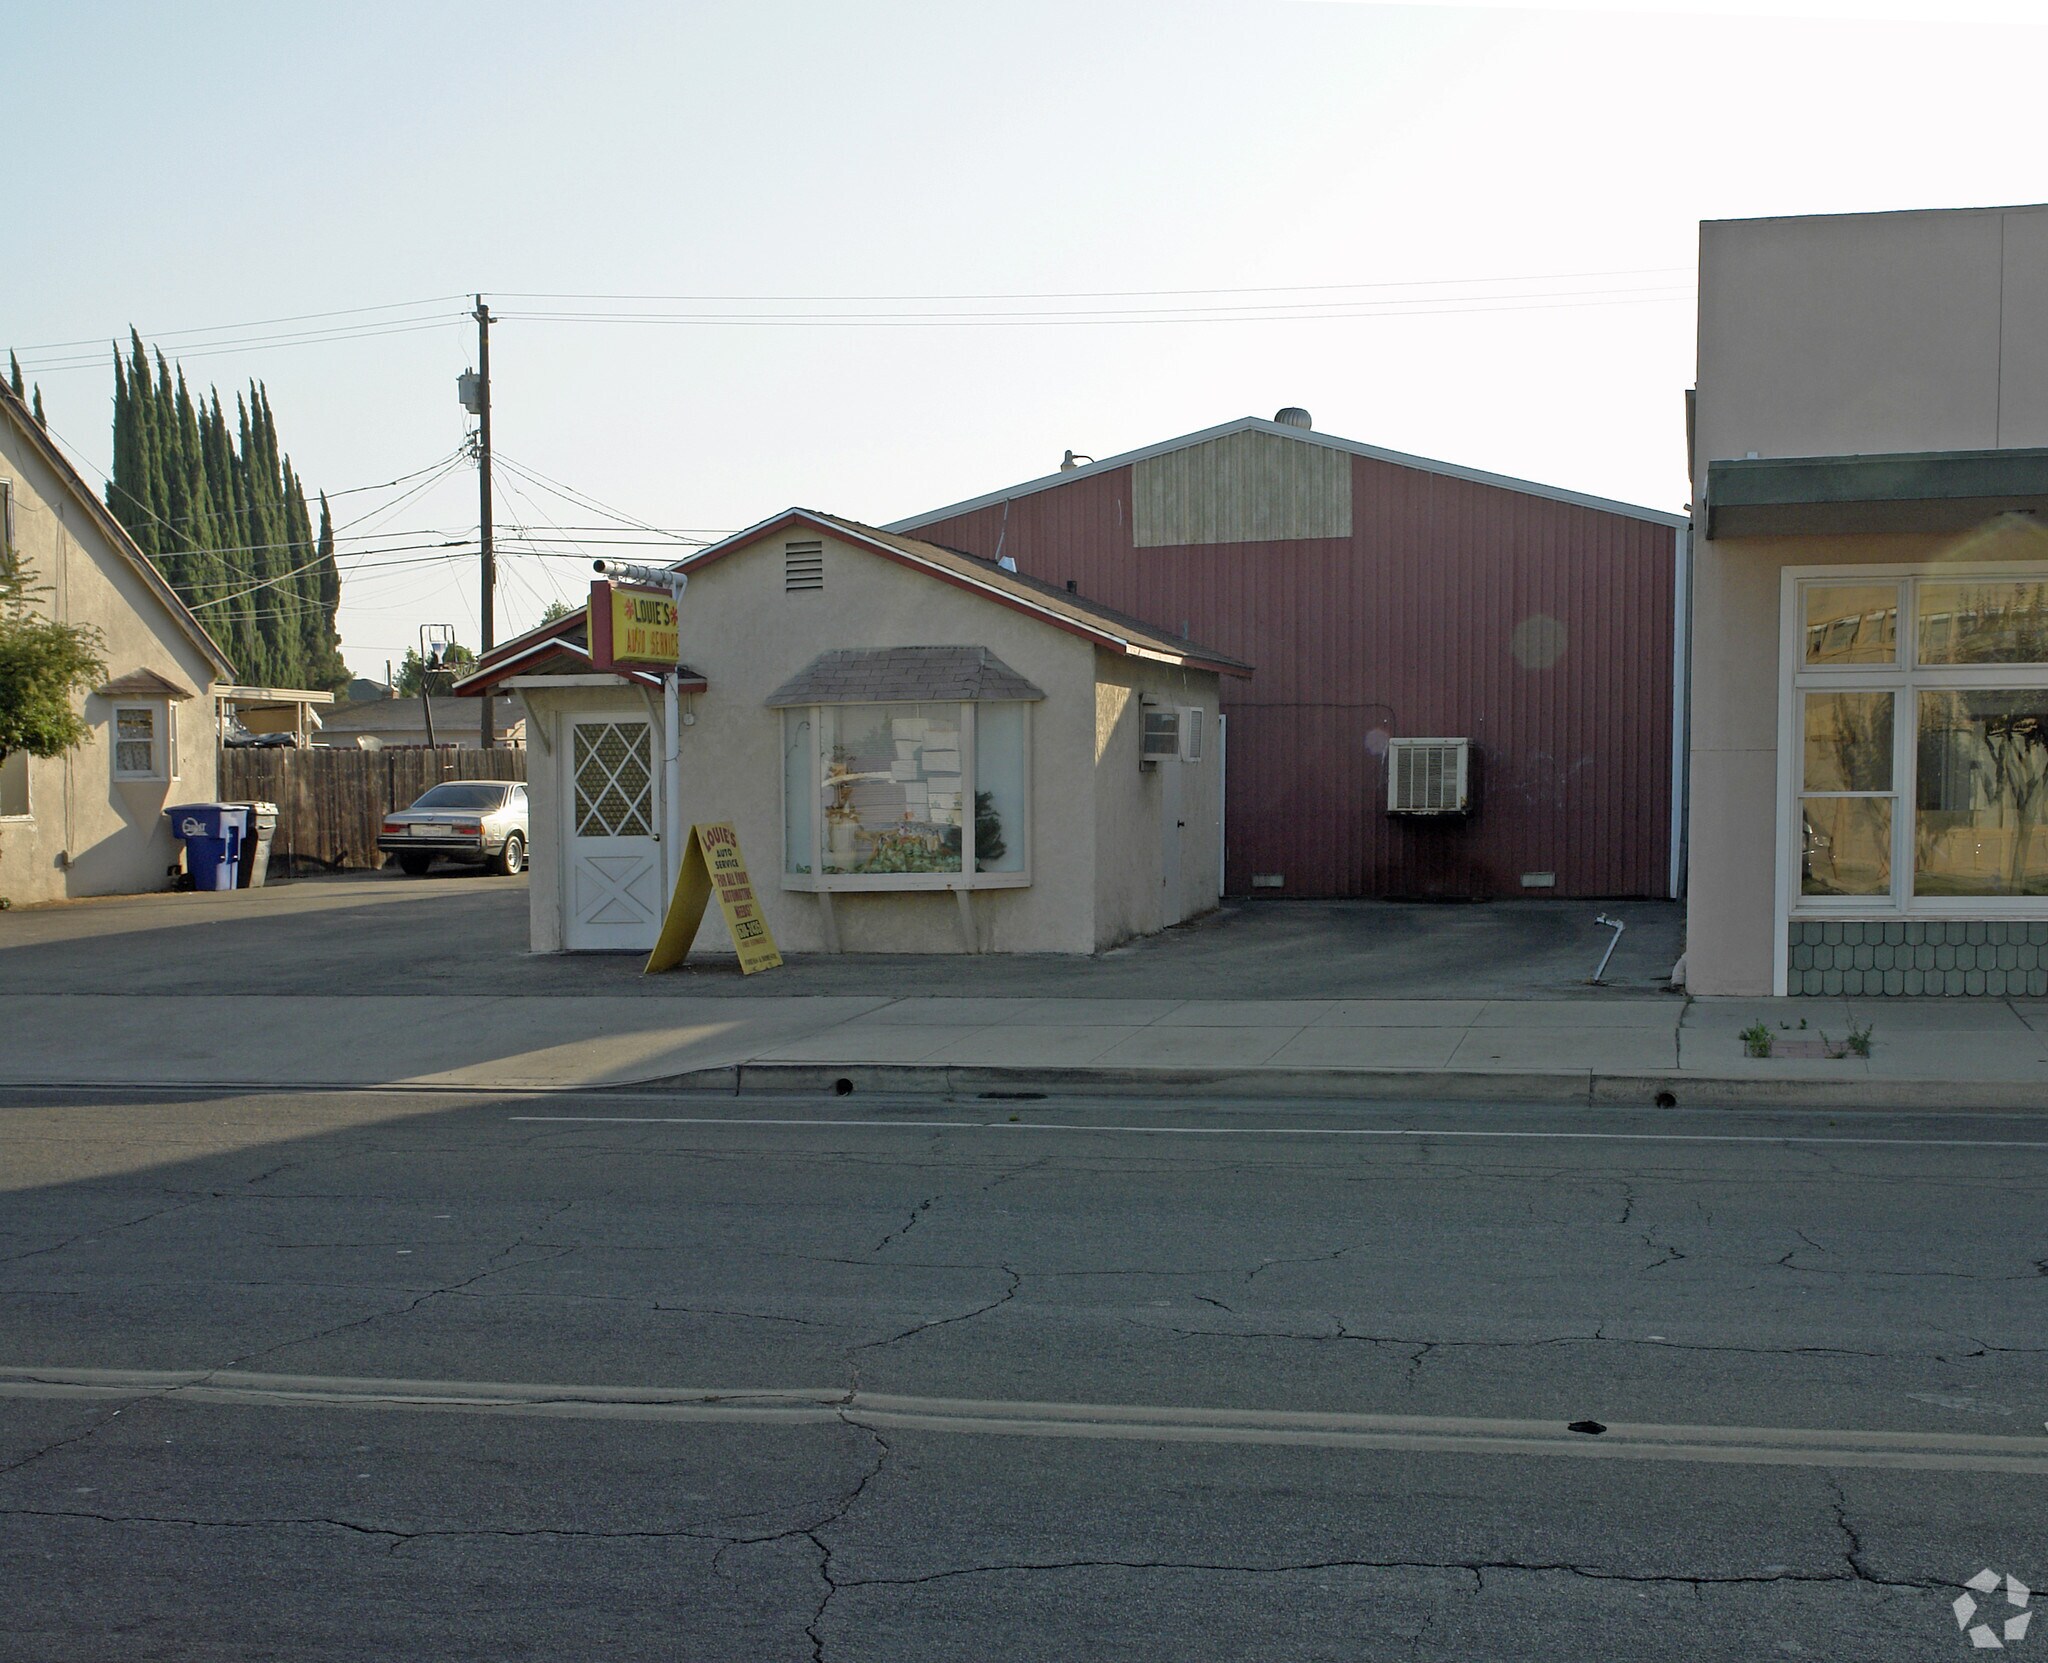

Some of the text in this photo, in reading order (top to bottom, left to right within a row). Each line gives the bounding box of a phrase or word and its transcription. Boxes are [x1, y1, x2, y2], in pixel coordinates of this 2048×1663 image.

[634, 598, 670, 626] LOUIE'S
[626, 627, 680, 657] AUTO SERVICE
[702, 826, 737, 853] LOUIE'S
[717, 848, 733, 857] AUTO
[715, 859, 739, 870] SERVICE
[722, 888, 752, 904] AUTOMOTIVE
